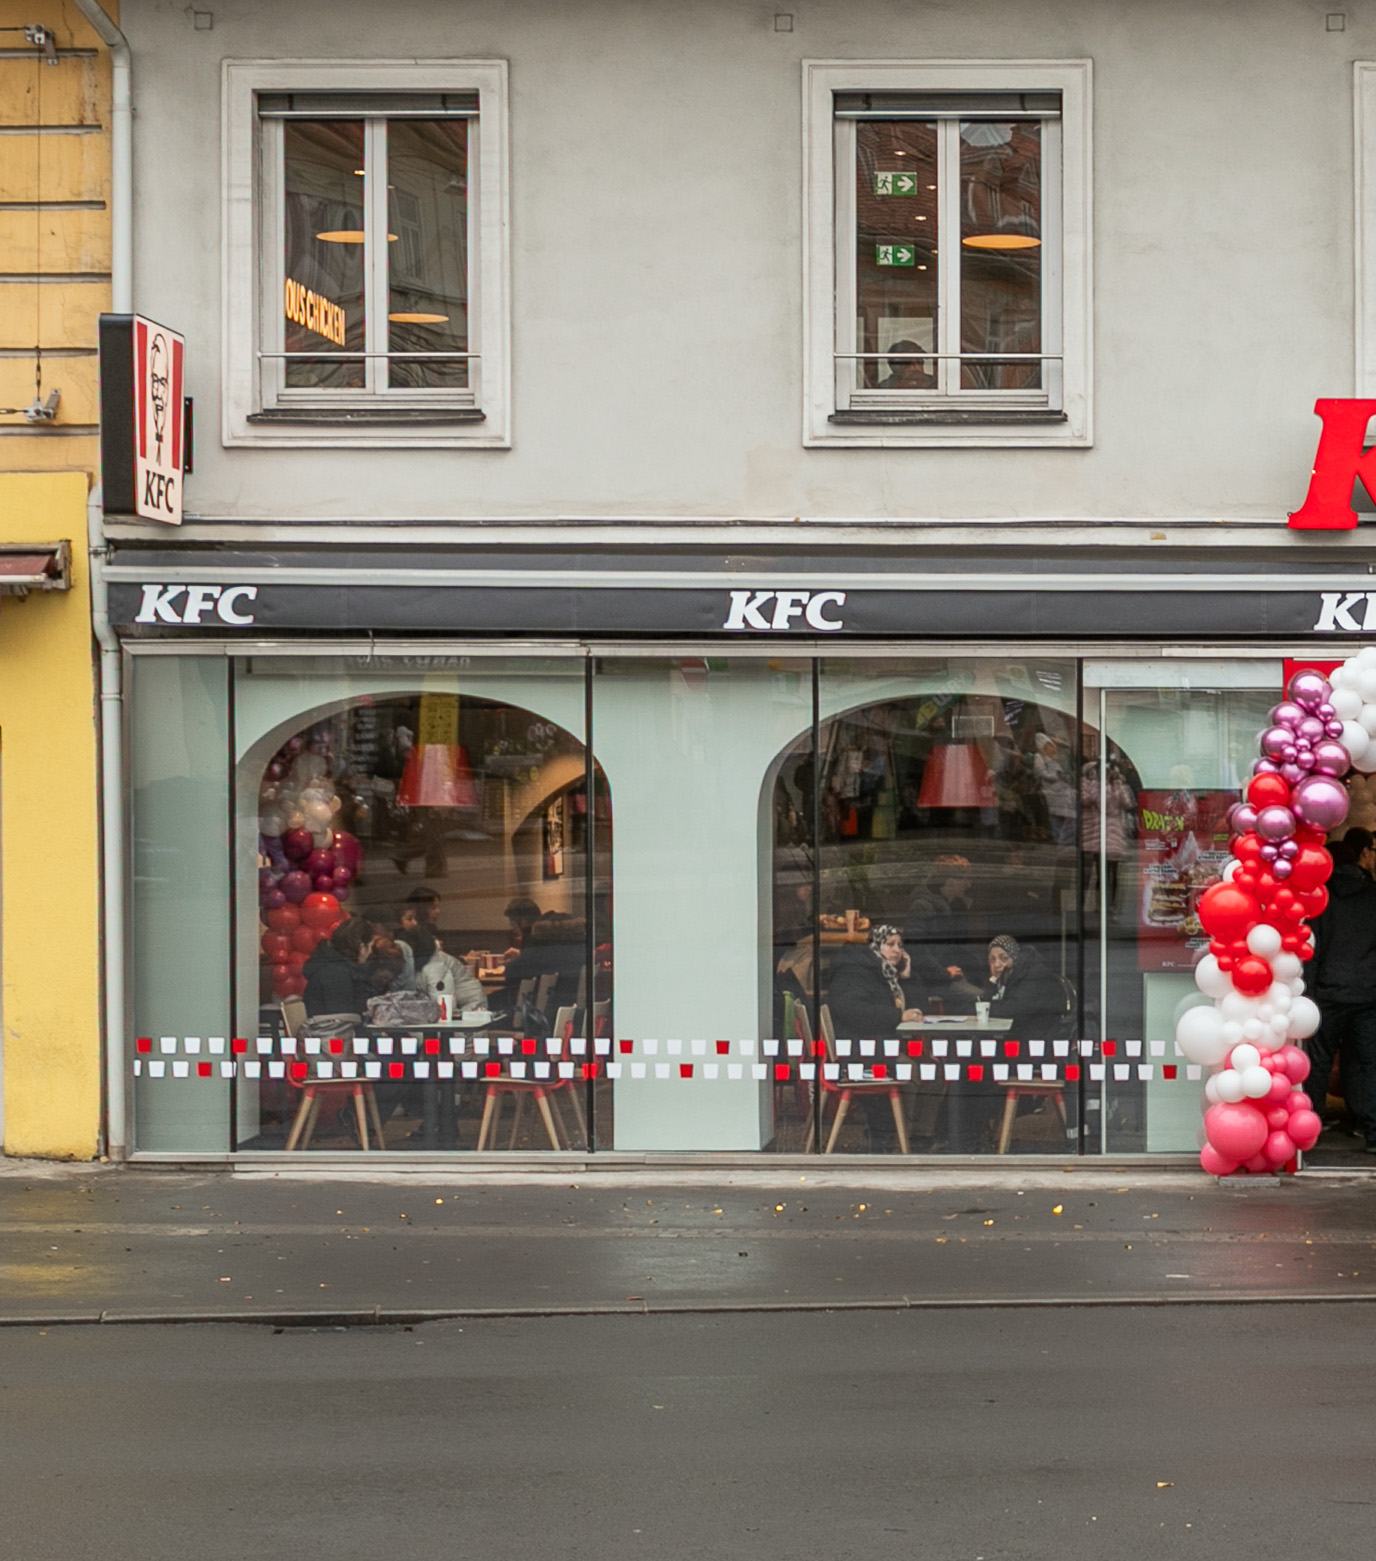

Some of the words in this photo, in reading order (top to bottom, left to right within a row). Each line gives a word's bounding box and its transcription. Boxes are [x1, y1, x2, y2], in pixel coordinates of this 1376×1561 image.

[306, 289, 346, 347] CHICKEN
[144, 470, 175, 514] KFC
[134, 584, 258, 625] KFC
[723, 590, 846, 631] KFC
